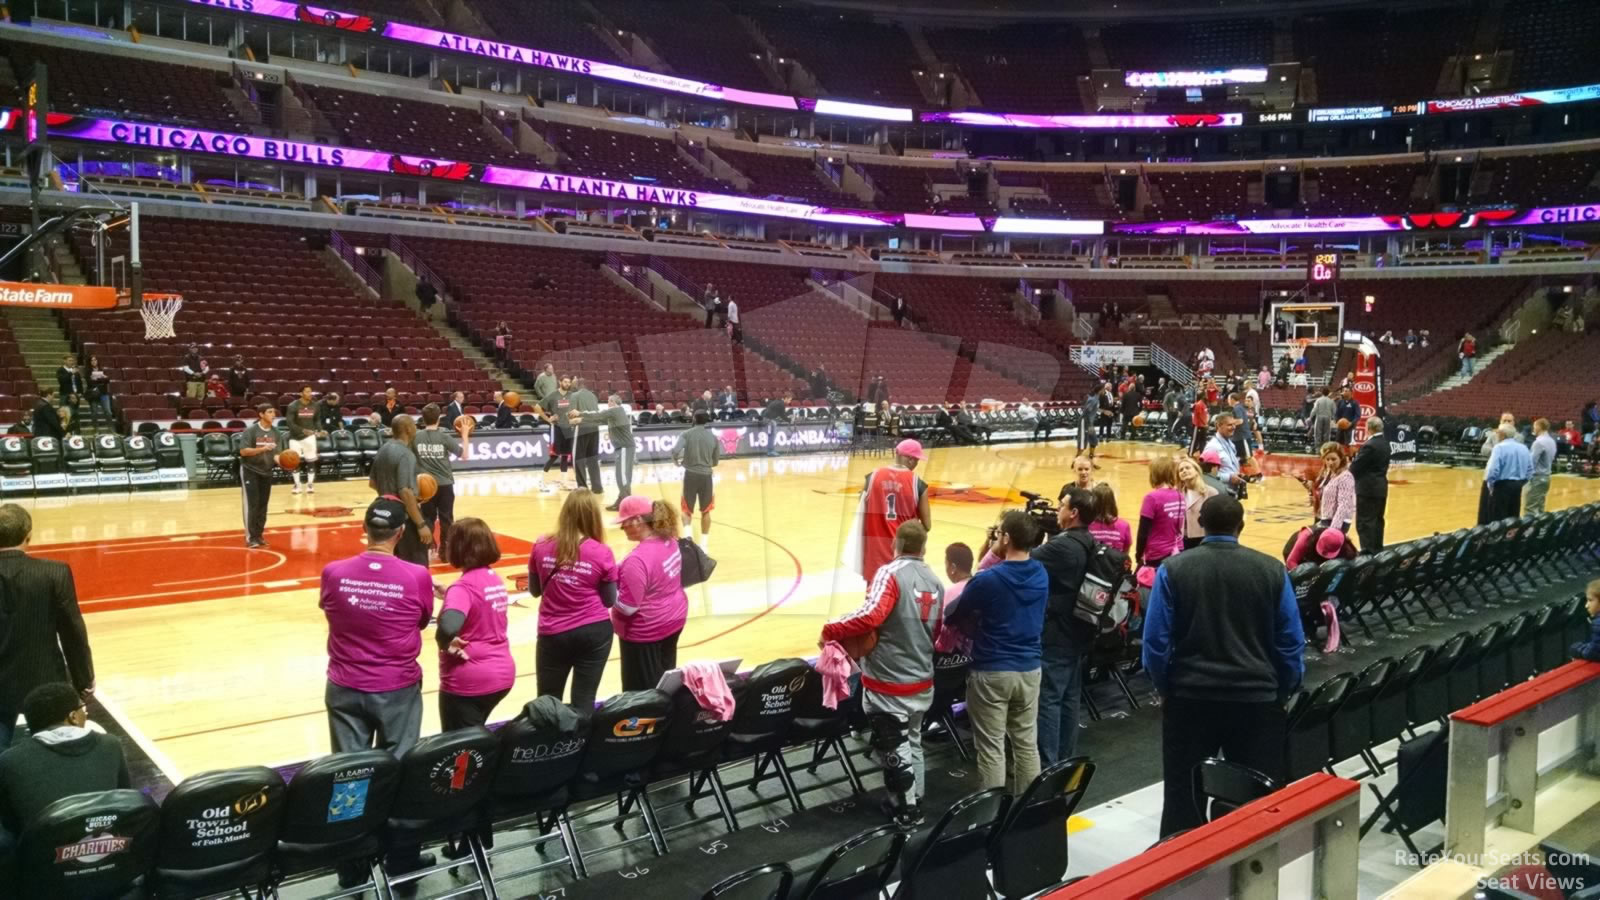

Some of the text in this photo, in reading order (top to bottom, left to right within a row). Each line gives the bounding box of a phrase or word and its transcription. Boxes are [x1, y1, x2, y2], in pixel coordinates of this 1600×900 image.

[439, 34, 592, 75] ATLANTA HAWKS
[1408, 104, 1418, 112] PM
[1436, 94, 1523, 109] CHICAGO BASKETBALL
[1259, 112, 1292, 122] 5:46 PM
[111, 123, 344, 166] CHICAGO BULLS
[540, 175, 698, 207] ATLANTA HAWKS
[1541, 207, 1600, 223] CHIC
[1270, 222, 1301, 230] Advocate
[1304, 221, 1328, 229] Health
[1315, 253, 1337, 264] 12:00
[1096, 348, 1124, 356] Advocate
[1358, 381, 1372, 392] KIA
[1360, 405, 1373, 416] IA
[4, 437, 21, 451] G
[37, 437, 54, 451] G
[69, 435, 84, 449] G
[100, 435, 116, 449] G
[129, 436, 145, 449] G
[160, 432, 175, 446] G
[1389, 440, 1416, 455] SPALDING
[37, 478, 66, 486] GEICO
[886, 493, 897, 520] 1
[339, 586, 404, 598] #StoriesOfTheGirls
[341, 579, 404, 591] #SupportYourGirls
[360, 598, 387, 607] Advocate
[771, 685, 787, 694] Old
[761, 693, 785, 702] Town
[764, 698, 792, 709] School
[512, 746, 534, 760] the
[346, 767, 375, 777] RABIDA
[86, 815, 118, 823] CHICAGO
[202, 805, 230, 819] Old
[89, 820, 112, 828] BULLS
[186, 819, 230, 830] Town
[196, 820, 248, 838] School
[761, 818, 790, 834] 64
[202, 838, 224, 847] Folk
[224, 832, 251, 844] Music
[62, 839, 127, 860] CHARITIES
[699, 839, 729, 855] 65
[617, 866, 650, 880] 66
